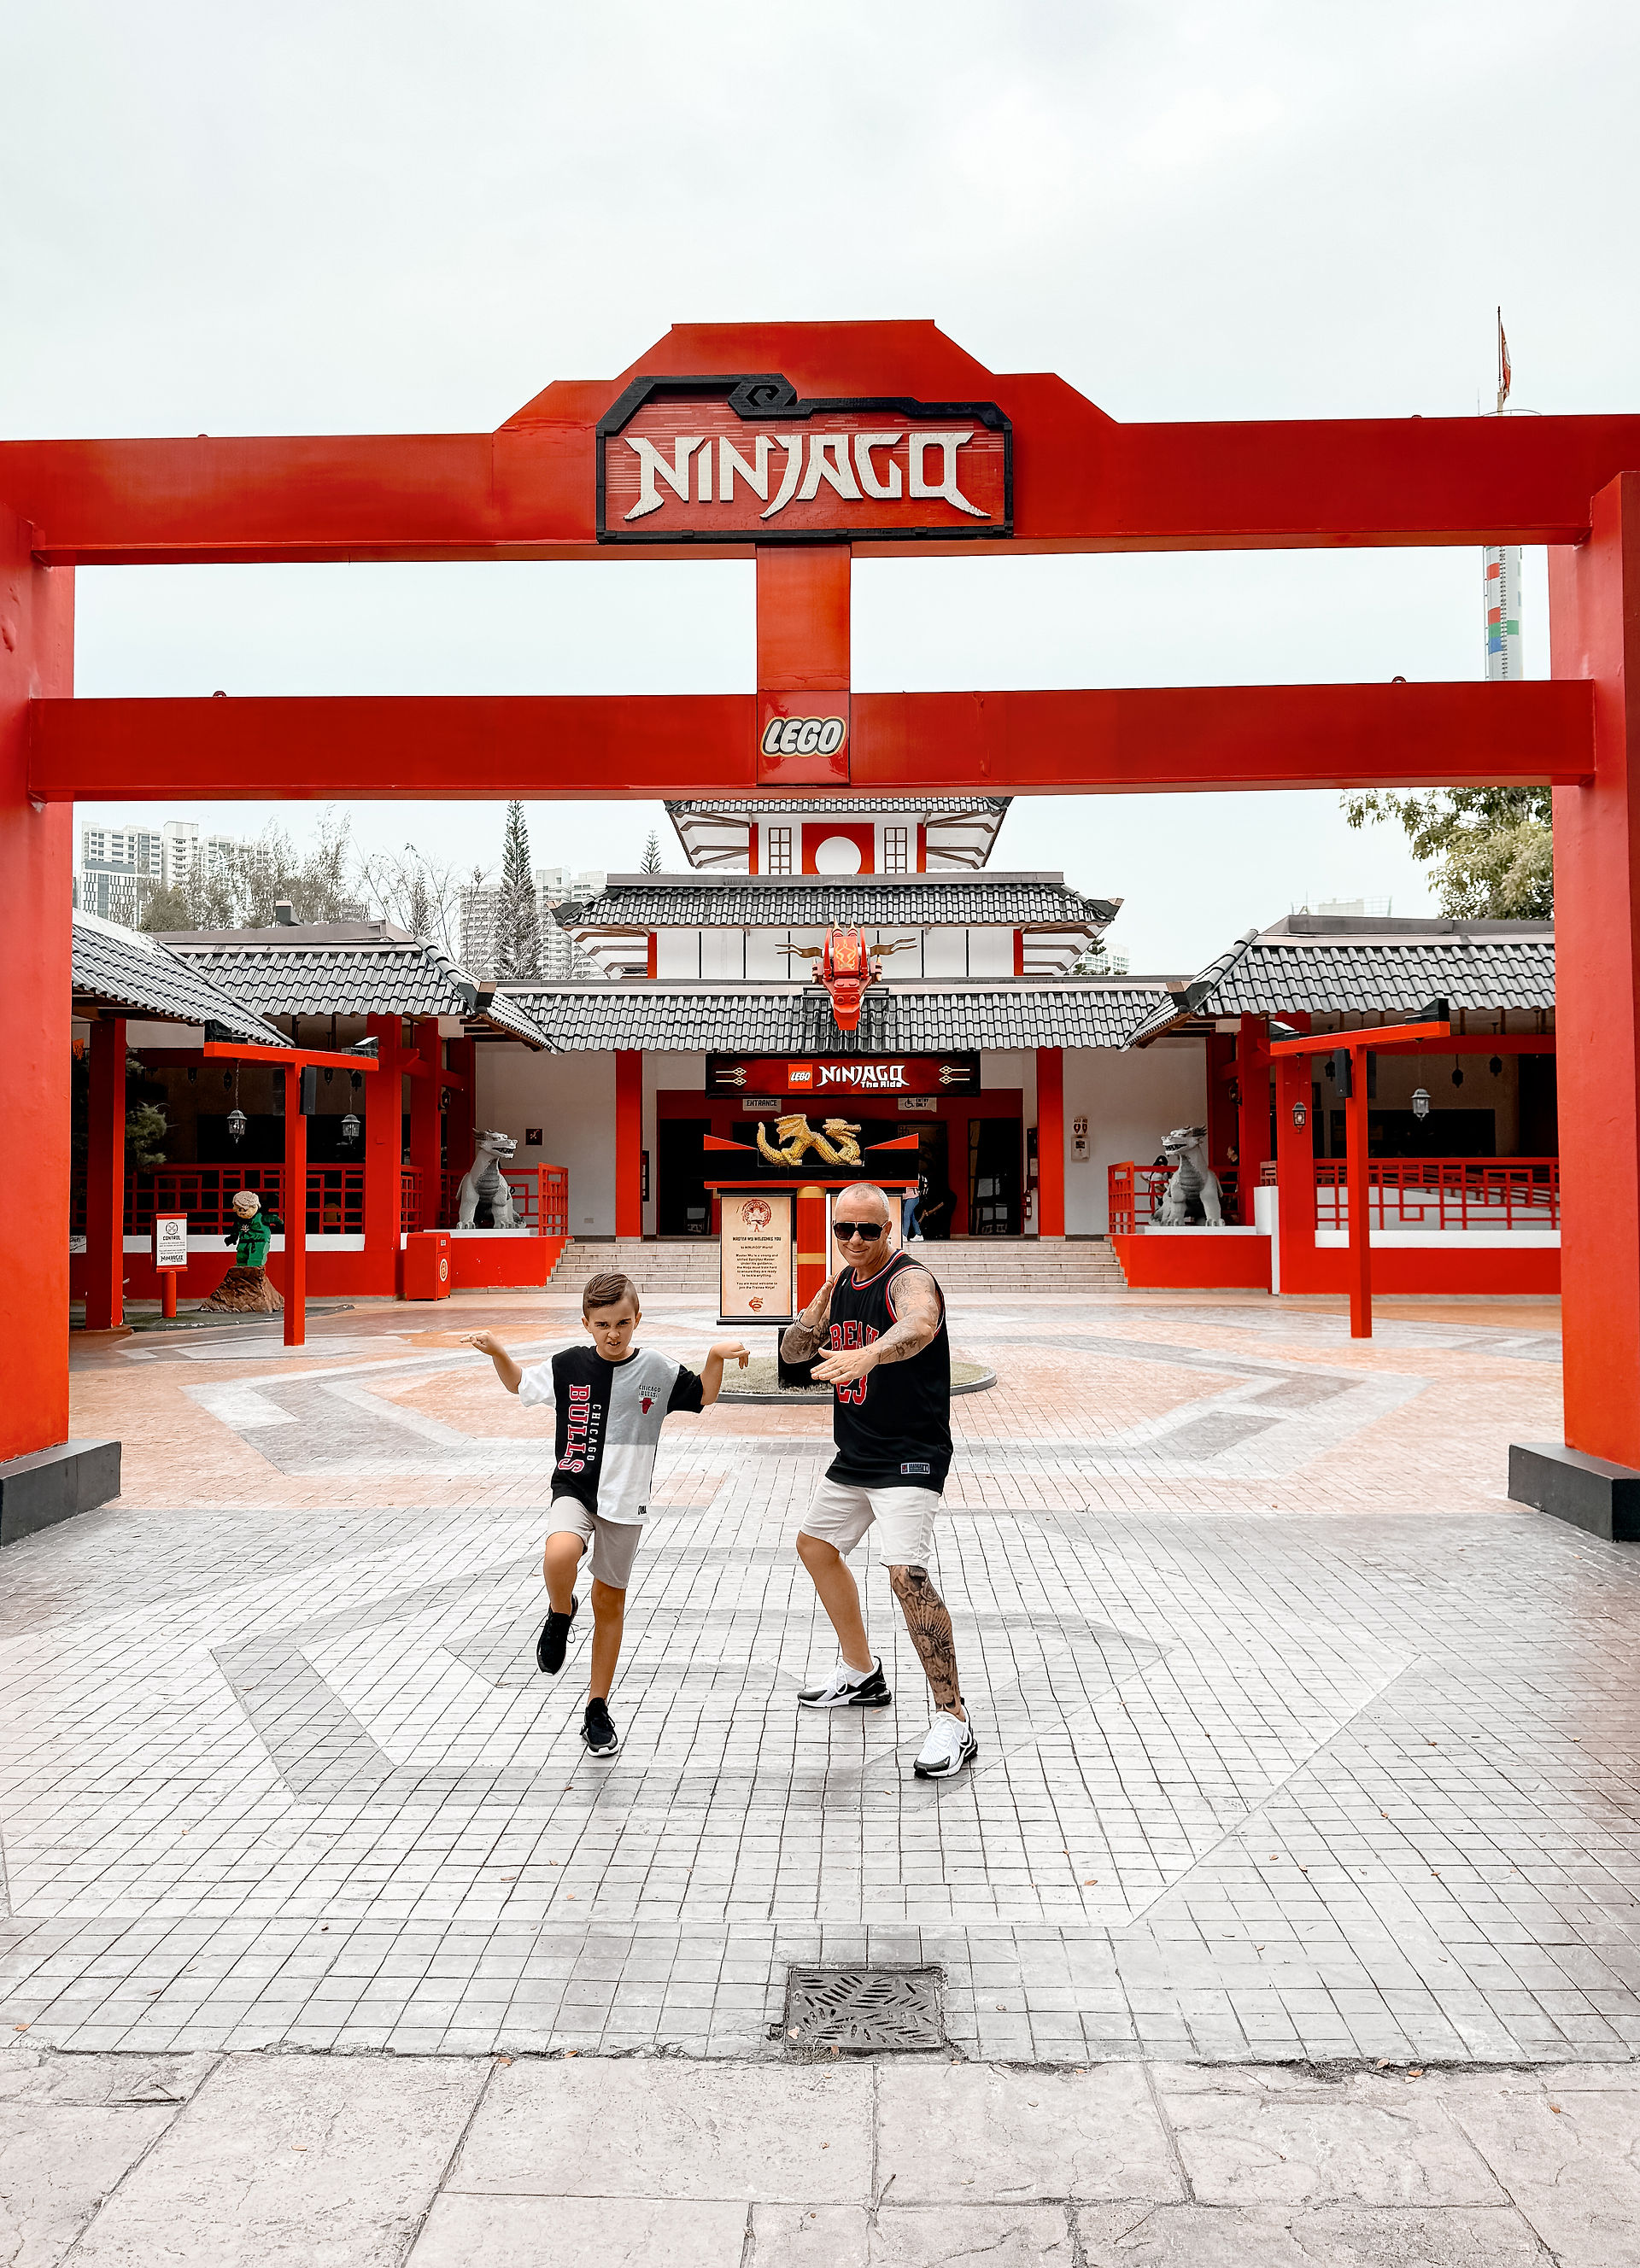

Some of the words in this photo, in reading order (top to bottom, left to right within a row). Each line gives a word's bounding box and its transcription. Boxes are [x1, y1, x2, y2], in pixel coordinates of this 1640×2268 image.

[624, 432, 991, 520] NINJAGO
[762, 718, 846, 756] LEGO
[790, 1071, 811, 1082] LEGO
[816, 1065, 911, 1087] NINJAGO
[558, 1384, 591, 1473] BULLS
[587, 1404, 601, 1461] CHICAGO
